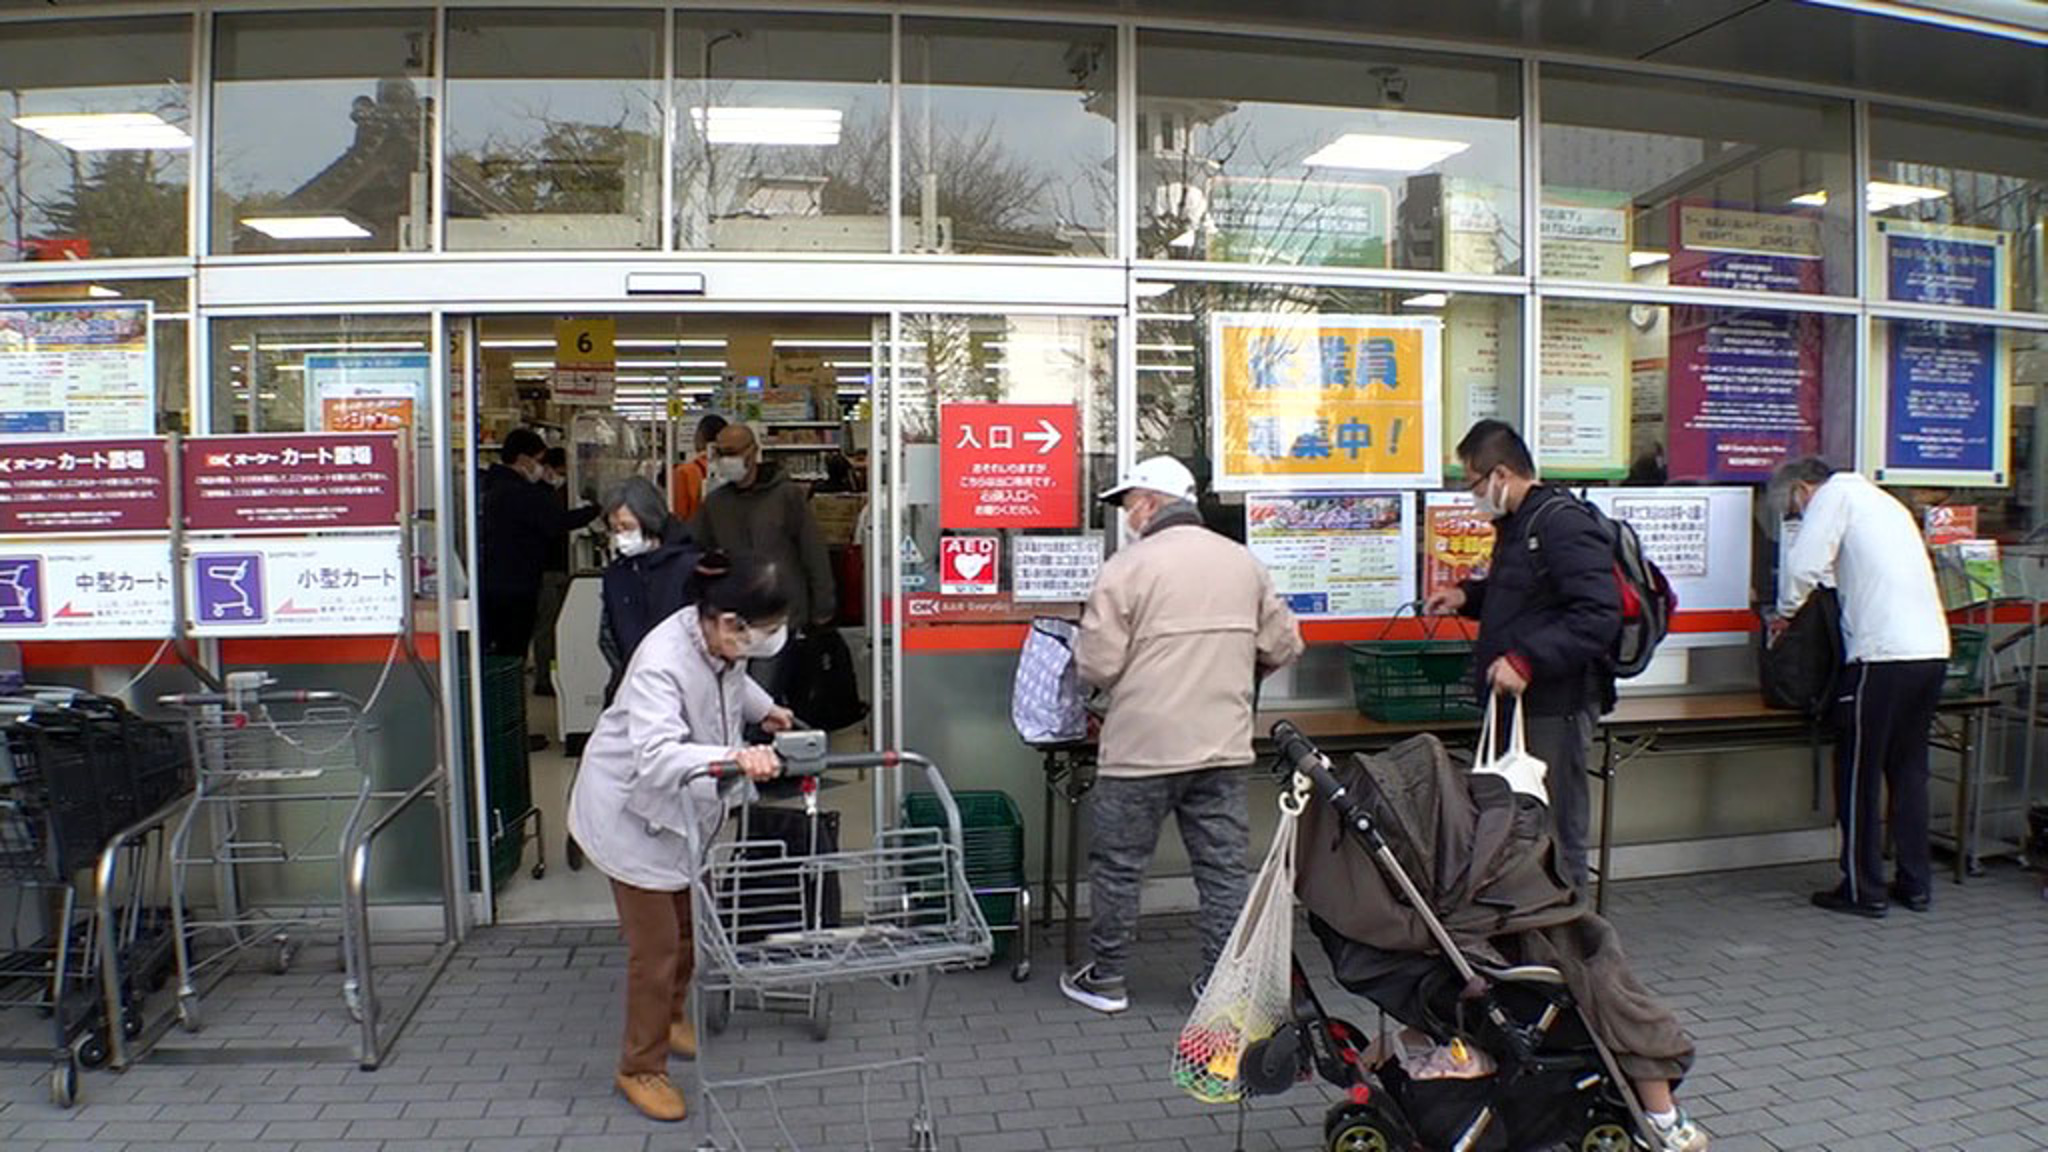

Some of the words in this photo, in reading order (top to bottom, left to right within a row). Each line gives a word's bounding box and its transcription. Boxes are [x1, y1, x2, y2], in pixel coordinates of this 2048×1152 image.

[577, 332, 593, 353] 6
[1249, 336, 1399, 390] 従業員
[956, 424, 1014, 449] 入口
[281, 446, 372, 466] カート置場
[973, 463, 1047, 474] おそれいりますが
[946, 540, 993, 554] AED
[76, 571, 169, 592] 中型カート
[298, 567, 396, 589] 小型カート
